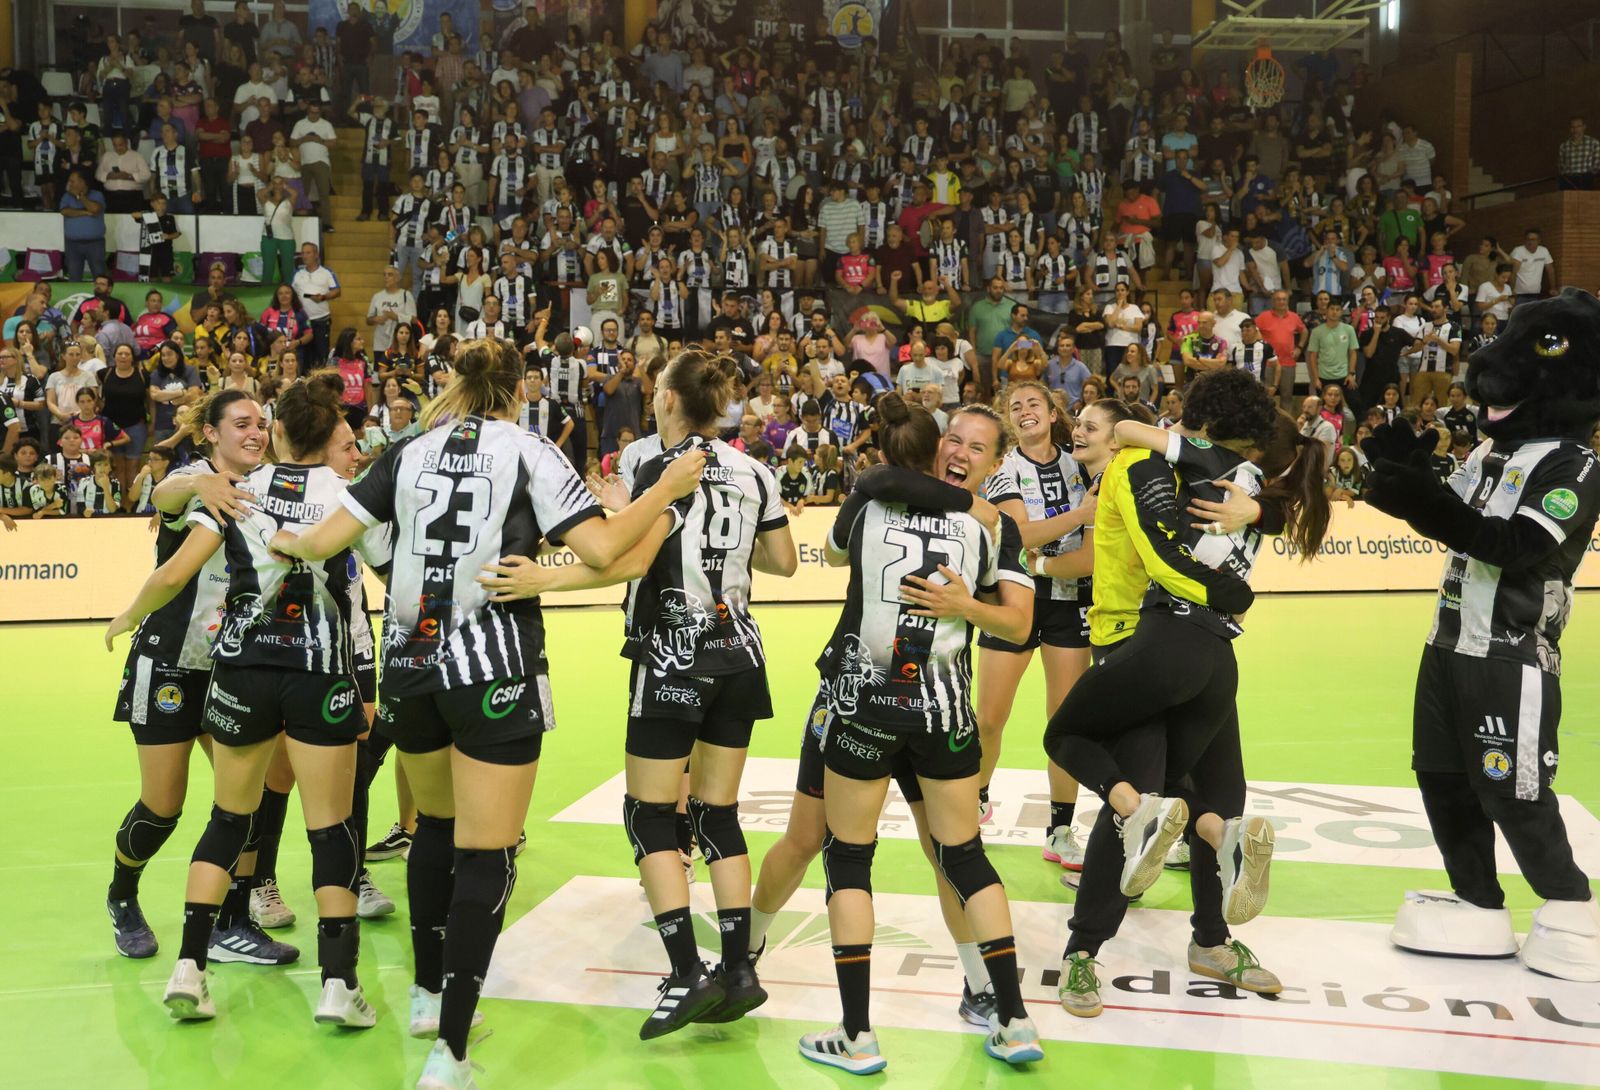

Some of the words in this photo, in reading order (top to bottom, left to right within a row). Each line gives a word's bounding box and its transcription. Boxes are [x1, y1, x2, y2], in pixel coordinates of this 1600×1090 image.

[1042, 481, 1062, 501] 57
[1480, 476, 1494, 501] 8
[411, 471, 493, 557] 23
[1357, 534, 1433, 559] Logístico
[0, 562, 79, 580] nmano
[330, 689, 355, 711] CSIF
[491, 684, 526, 705] CSIF
[654, 690, 702, 706] TORRES
[206, 708, 242, 735] TORRES
[836, 734, 884, 761] TORRES
